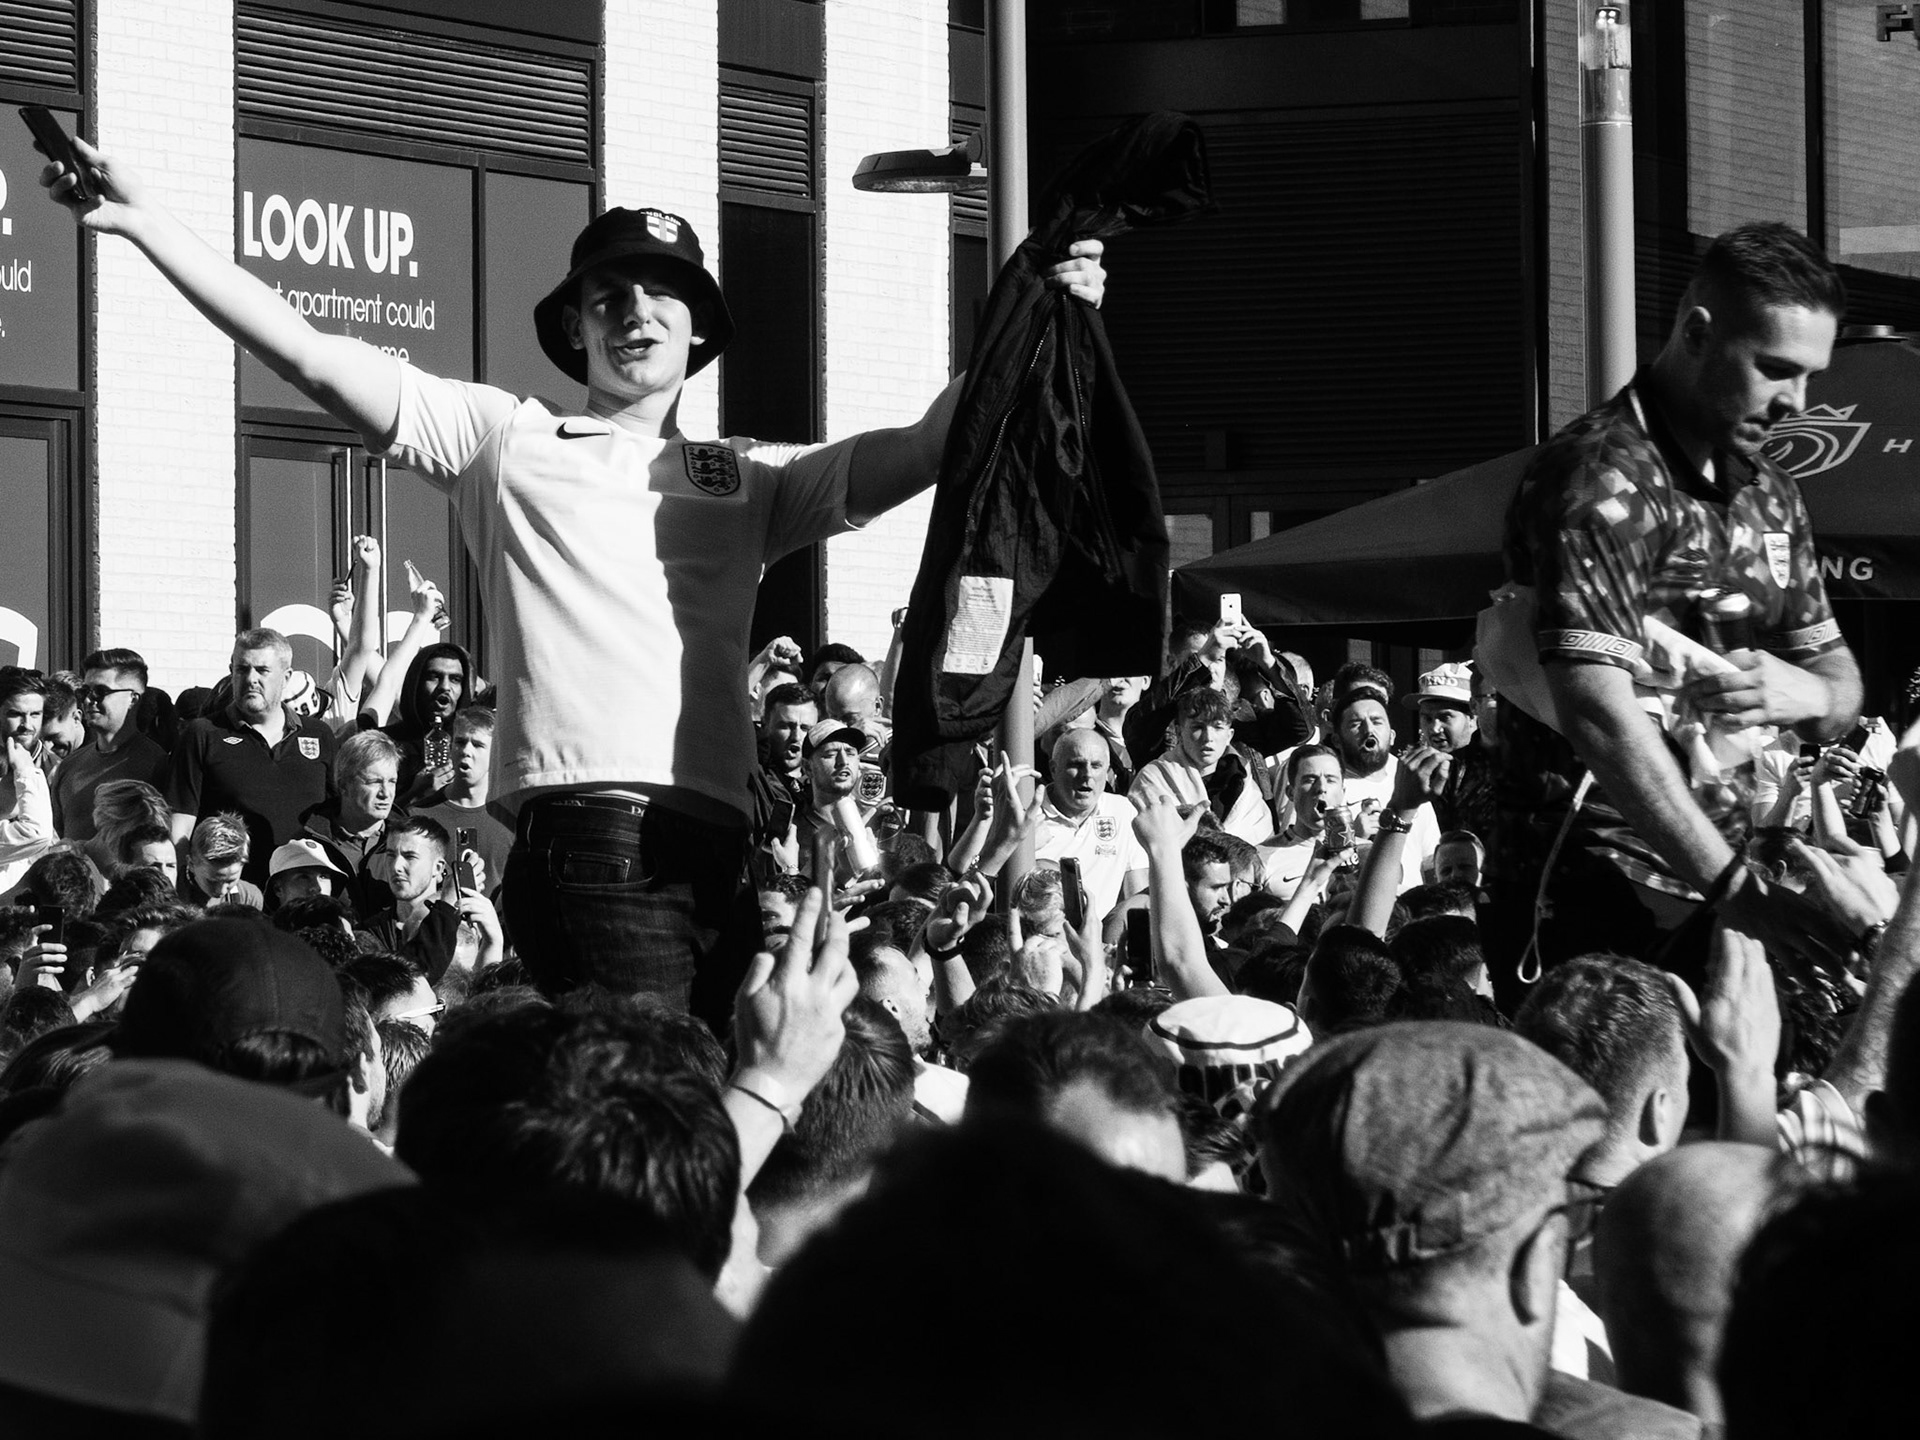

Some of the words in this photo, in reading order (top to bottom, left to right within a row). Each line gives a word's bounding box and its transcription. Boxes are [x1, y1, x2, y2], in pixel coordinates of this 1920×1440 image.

[243, 190, 355, 269] LOOK
[364, 207, 419, 278] UP.
[0, 258, 32, 293] uld
[287, 288, 382, 324] apartment
[385, 298, 435, 331] could
[1882, 439, 1914, 453] H
